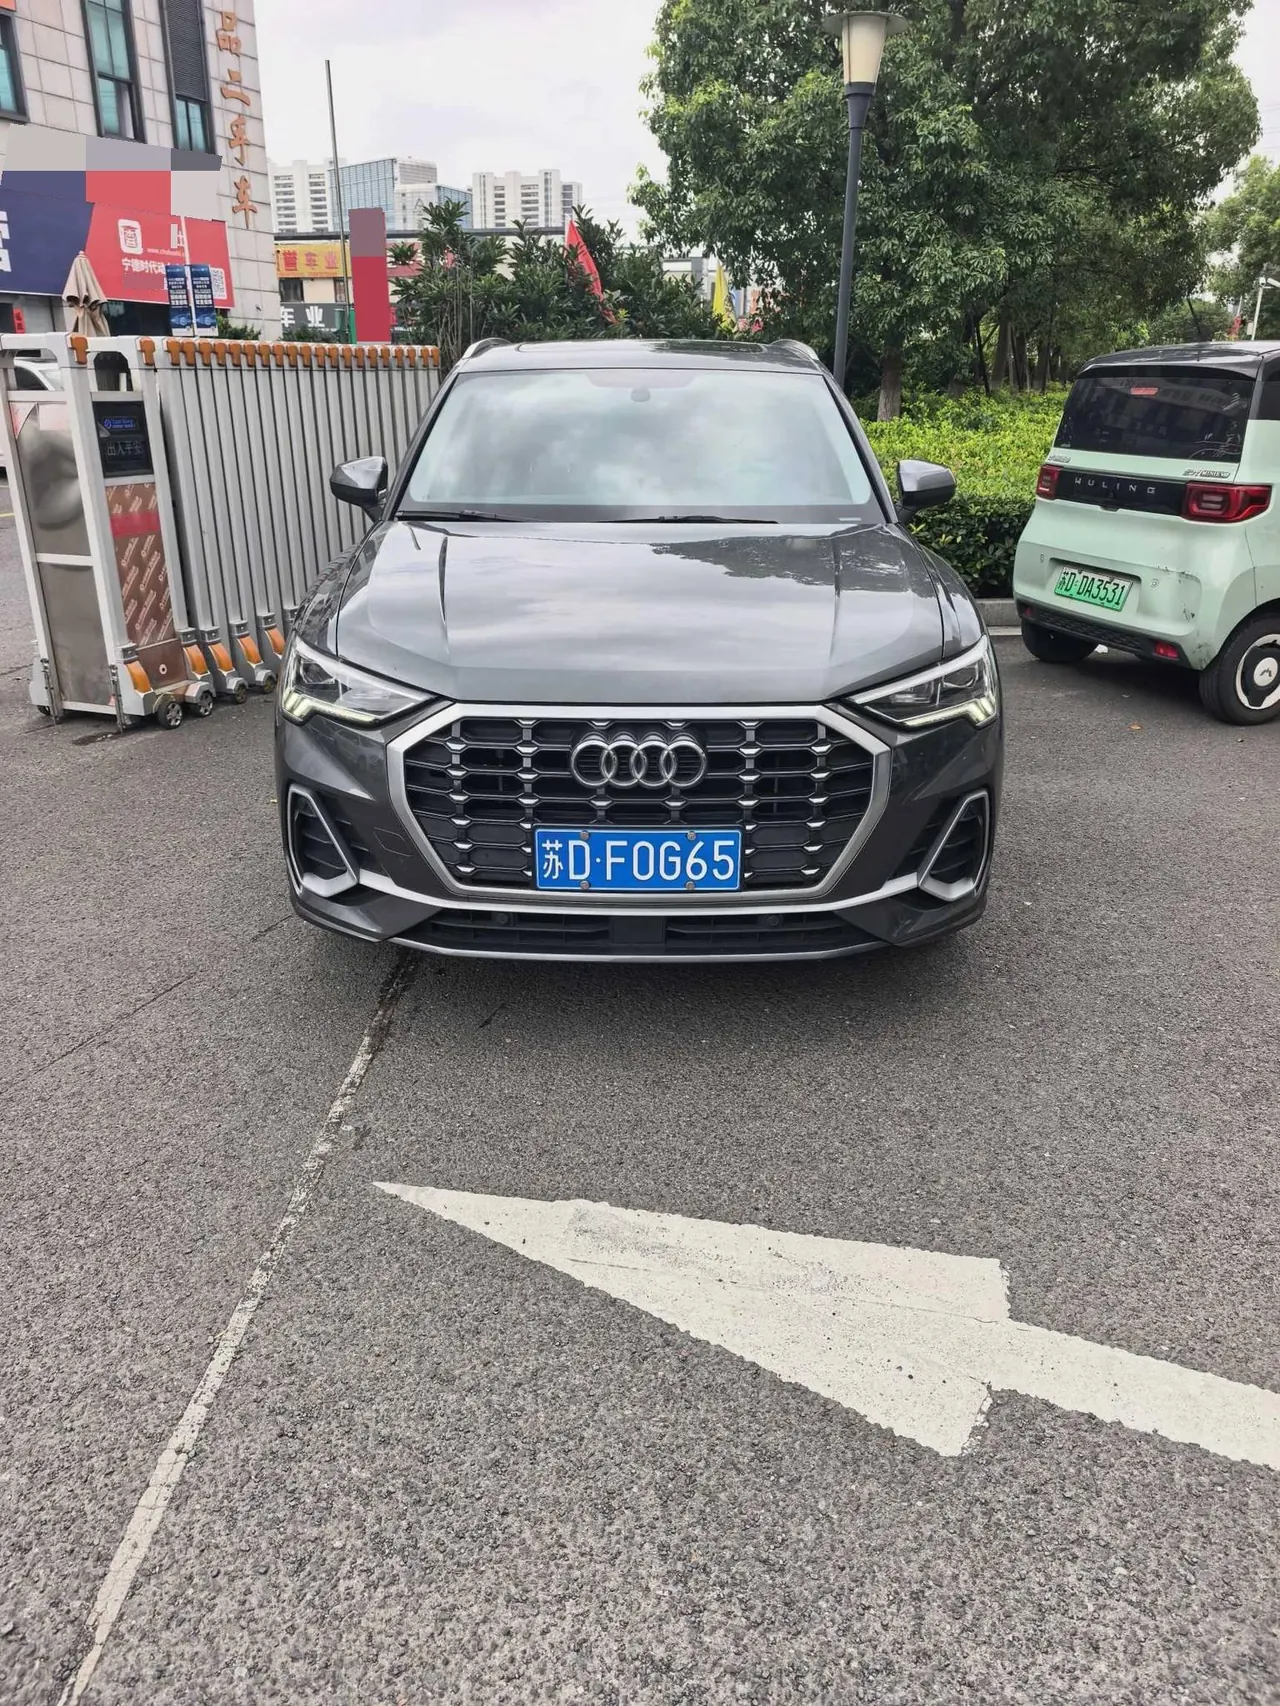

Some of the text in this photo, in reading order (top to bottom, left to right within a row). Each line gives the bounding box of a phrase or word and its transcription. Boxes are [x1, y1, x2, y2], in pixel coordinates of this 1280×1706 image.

[216, 11, 258, 229] 品二手车
[121, 256, 170, 275] 宁德时代动
[1074, 476, 1156, 495] WULING
[541, 839, 735, 881] 苏D·F0G65
